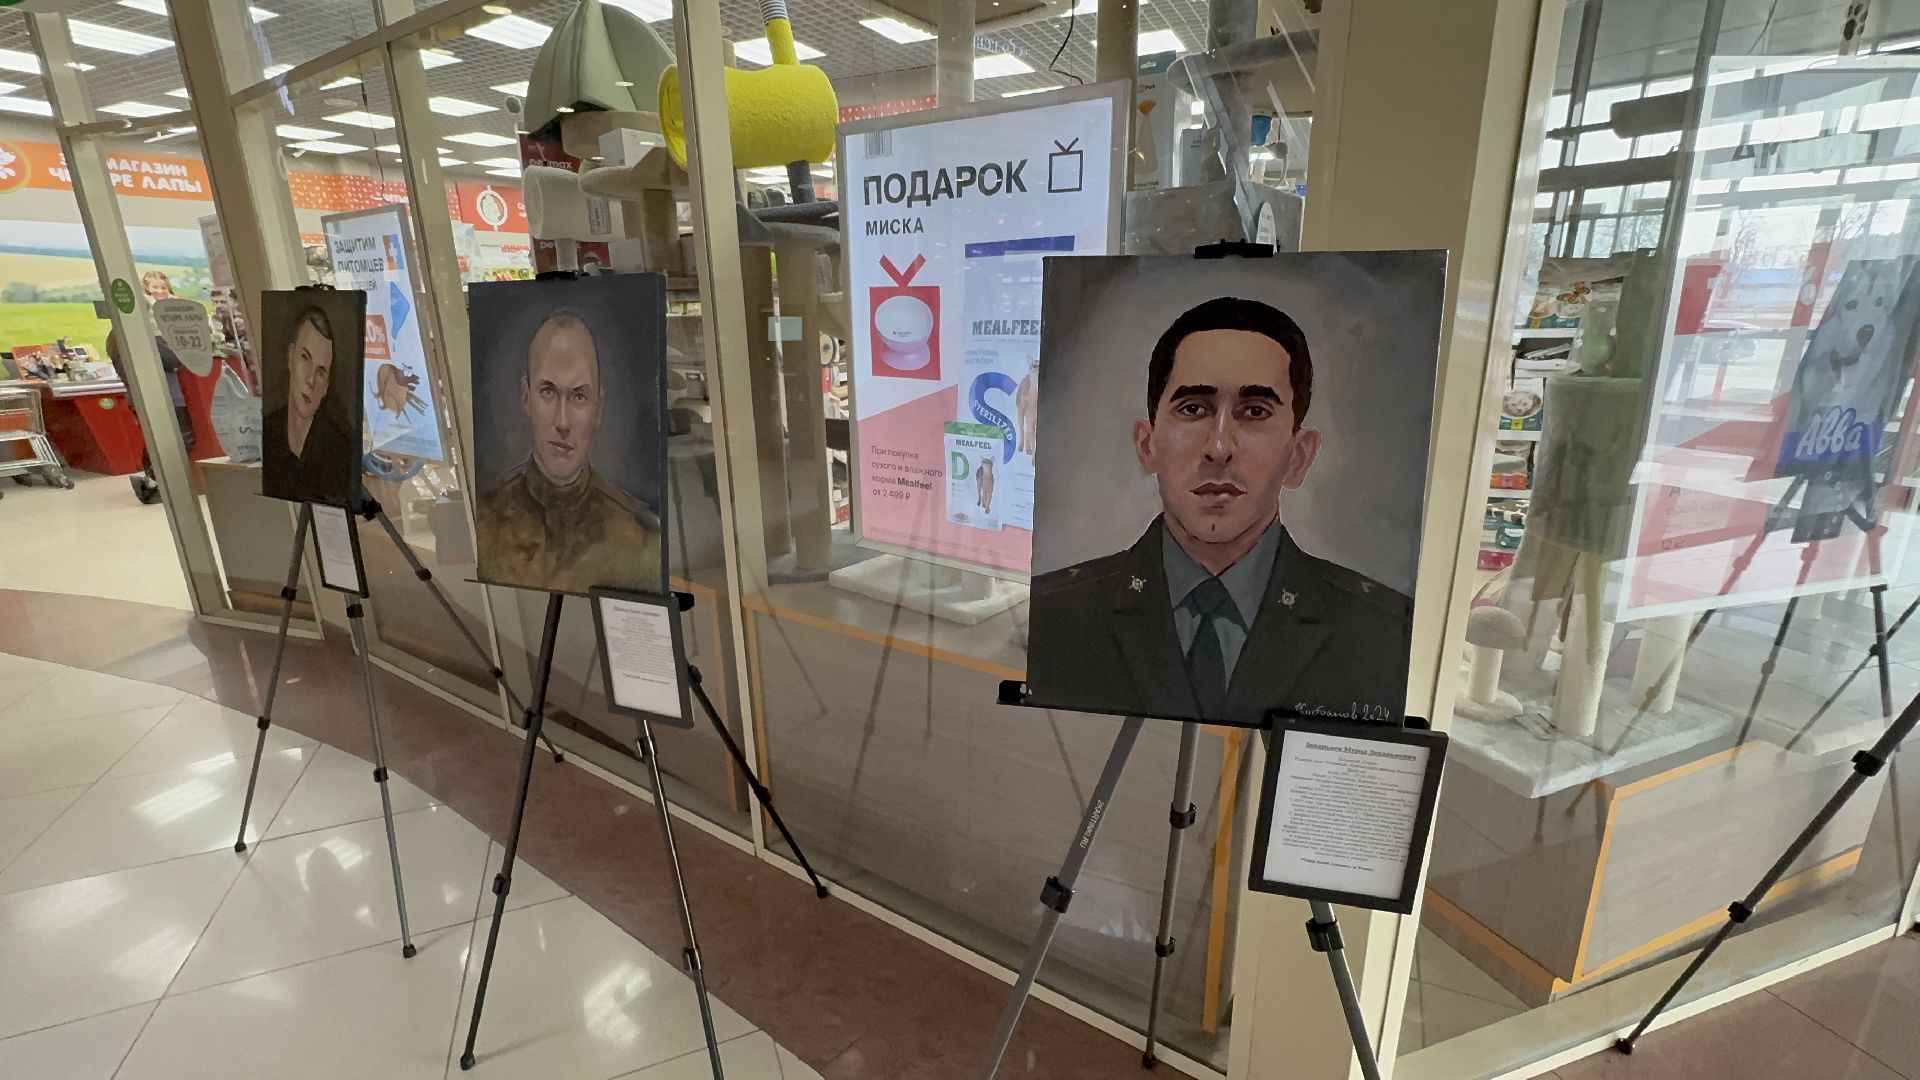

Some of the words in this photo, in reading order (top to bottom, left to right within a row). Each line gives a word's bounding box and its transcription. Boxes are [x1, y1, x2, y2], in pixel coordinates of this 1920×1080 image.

[59, 152, 188, 177] ЗМАГАЗИН
[529, 159, 573, 169] pemax
[142, 176, 202, 193] ЛАПЫ
[863, 158, 1028, 208] ПОДАРОК
[865, 217, 924, 236] МИСКА
[334, 236, 377, 255] ЗАЩИТИМ
[337, 258, 385, 275] ПИТОМЦЕВ
[365, 319, 386, 343] 0%
[972, 319, 1041, 336] MEALFEE
[174, 335, 203, 348] 10-22
[871, 445, 887, 456] При
[888, 449, 919, 460] покупке
[955, 439, 992, 450] MEALFEEL
[871, 461, 897, 471] сухого
[904, 465, 943, 478] влажного
[872, 475, 896, 485] корма
[897, 477, 932, 491] Mealfeel
[872, 488, 881, 496] от
